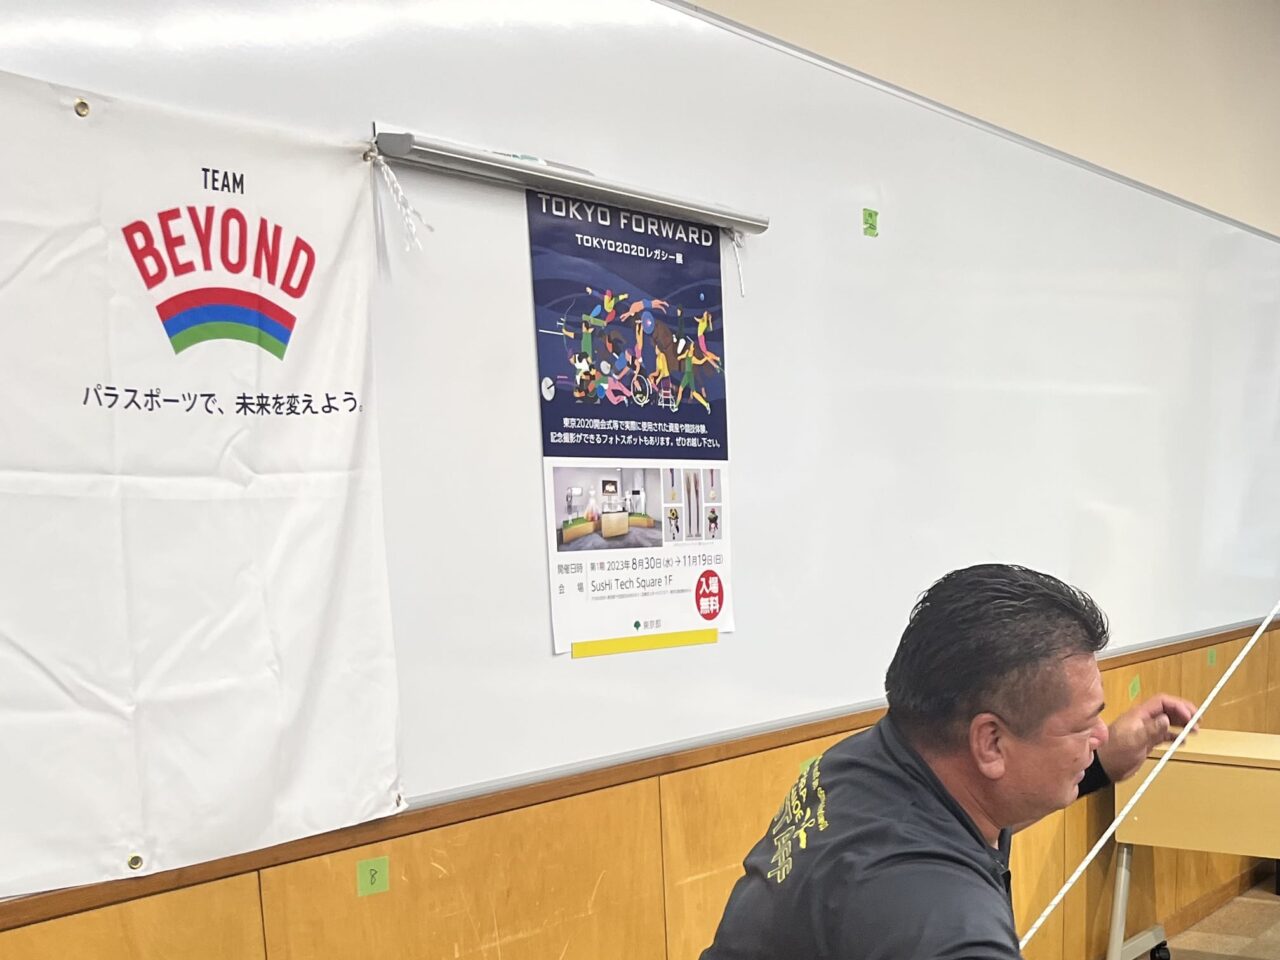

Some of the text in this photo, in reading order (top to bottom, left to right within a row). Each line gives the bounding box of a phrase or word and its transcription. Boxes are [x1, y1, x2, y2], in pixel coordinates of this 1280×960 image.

[201, 167, 245, 195] TEAM
[537, 193, 713, 247] TOKYO FORWARD
[121, 205, 316, 299] BEYOND
[82, 383, 364, 416] パラスポーツで、未来を変えよう。
[607, 559, 631, 571] 2023年
[591, 574, 673, 593] SusHi Tech Square 1F
[699, 576, 719, 595] 入場
[699, 596, 720, 615] 無料
